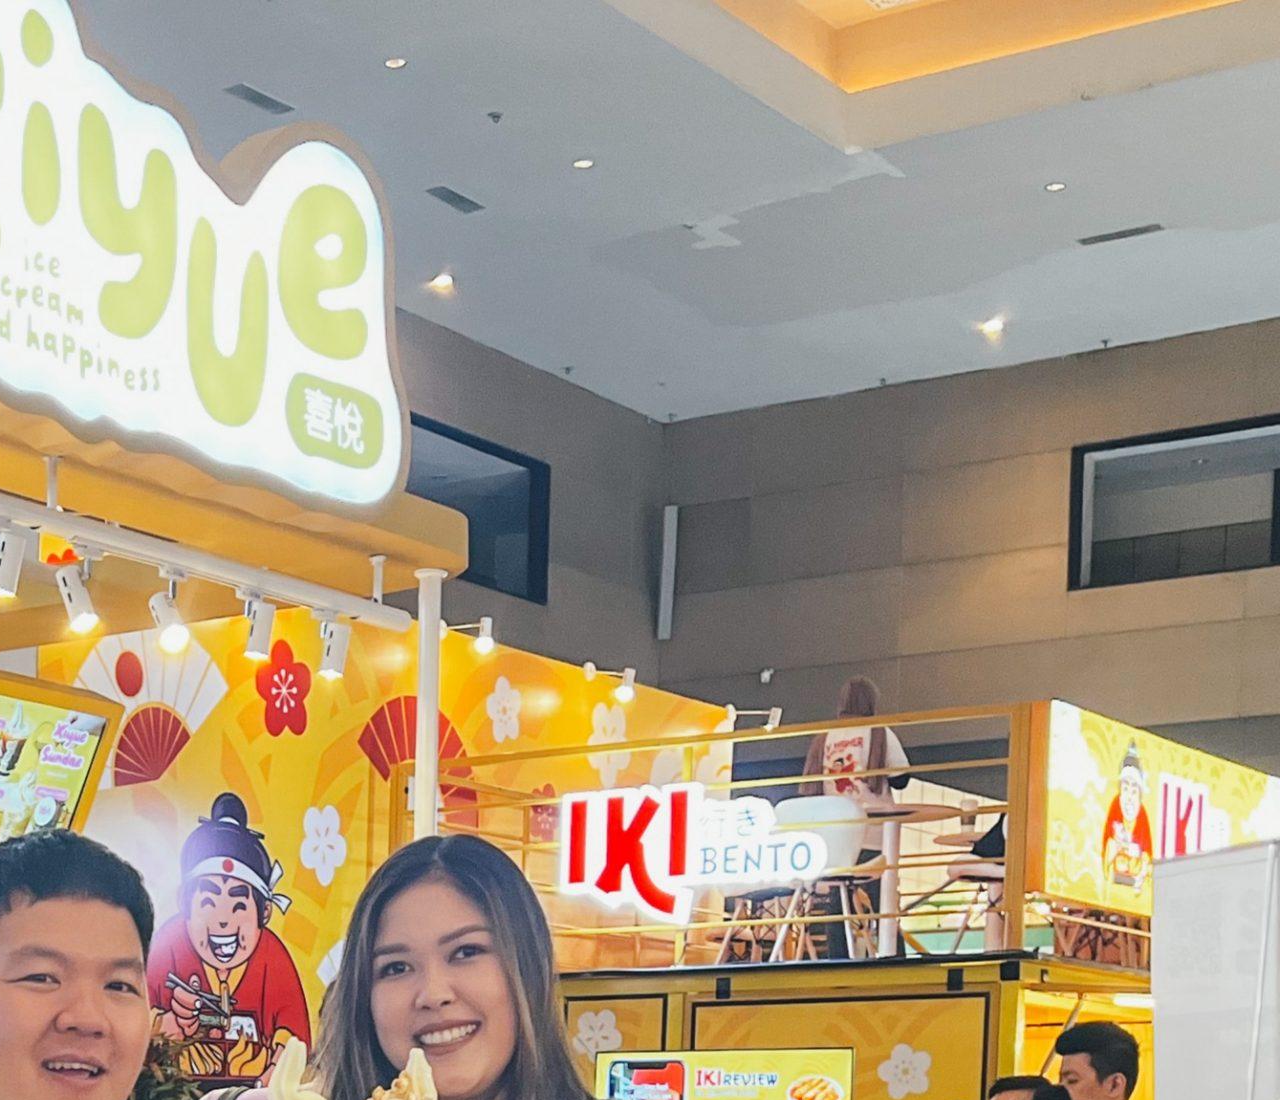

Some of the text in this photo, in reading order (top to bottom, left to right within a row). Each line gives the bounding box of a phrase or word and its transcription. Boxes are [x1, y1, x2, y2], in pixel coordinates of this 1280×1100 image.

[23, 252, 61, 279] ice
[0, 275, 85, 327] cream
[25, 314, 160, 392] happiness
[568, 790, 688, 915] IKI
[700, 841, 812, 876] BENTO
[695, 1069, 778, 1087] IKI REVIEW
